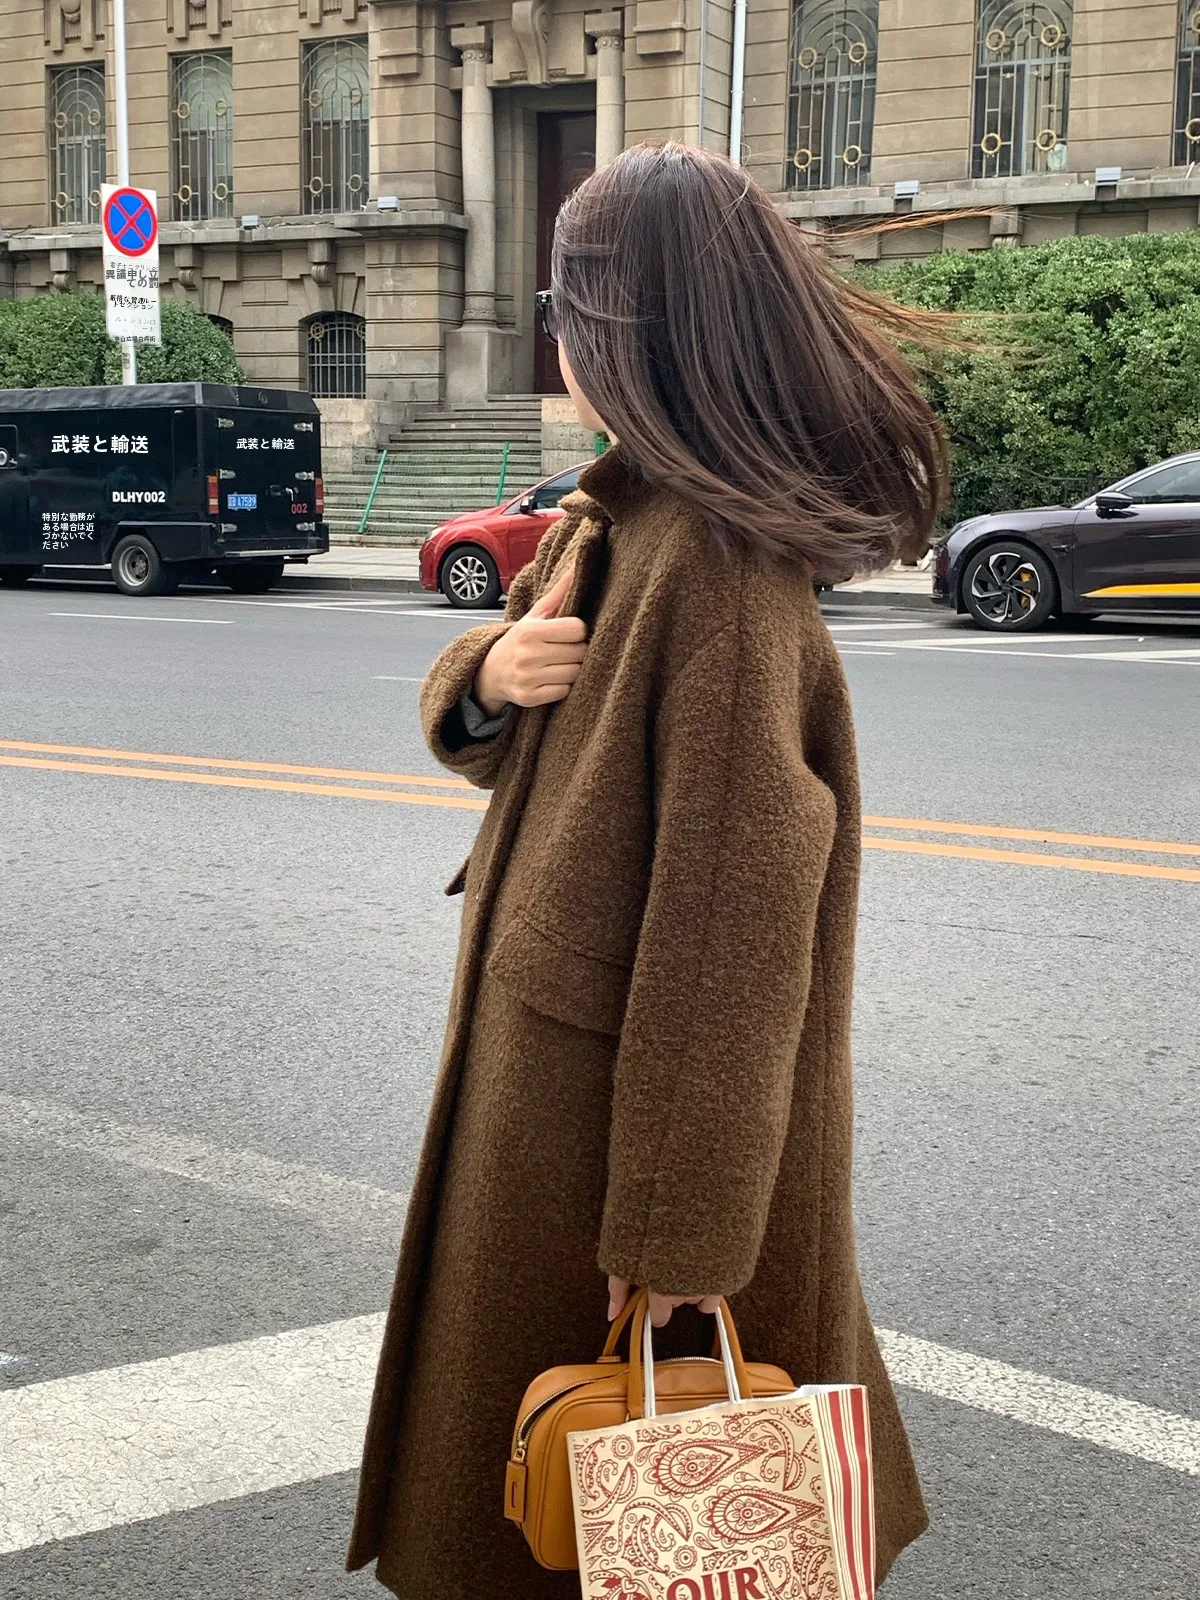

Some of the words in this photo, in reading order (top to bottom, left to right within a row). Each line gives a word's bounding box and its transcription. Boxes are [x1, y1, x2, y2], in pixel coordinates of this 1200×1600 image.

[105, 268, 158, 279] 異議申し立
[51, 435, 149, 454] 武装と輸送
[236, 437, 295, 450] 武装と輸送
[112, 491, 166, 503] DLHY002
[291, 504, 308, 514] 002
[42, 512, 95, 522] 特別な勤務が
[42, 522, 95, 532] ある場合は近
[42, 531, 94, 541] づかないでく
[42, 541, 69, 550] ださい
